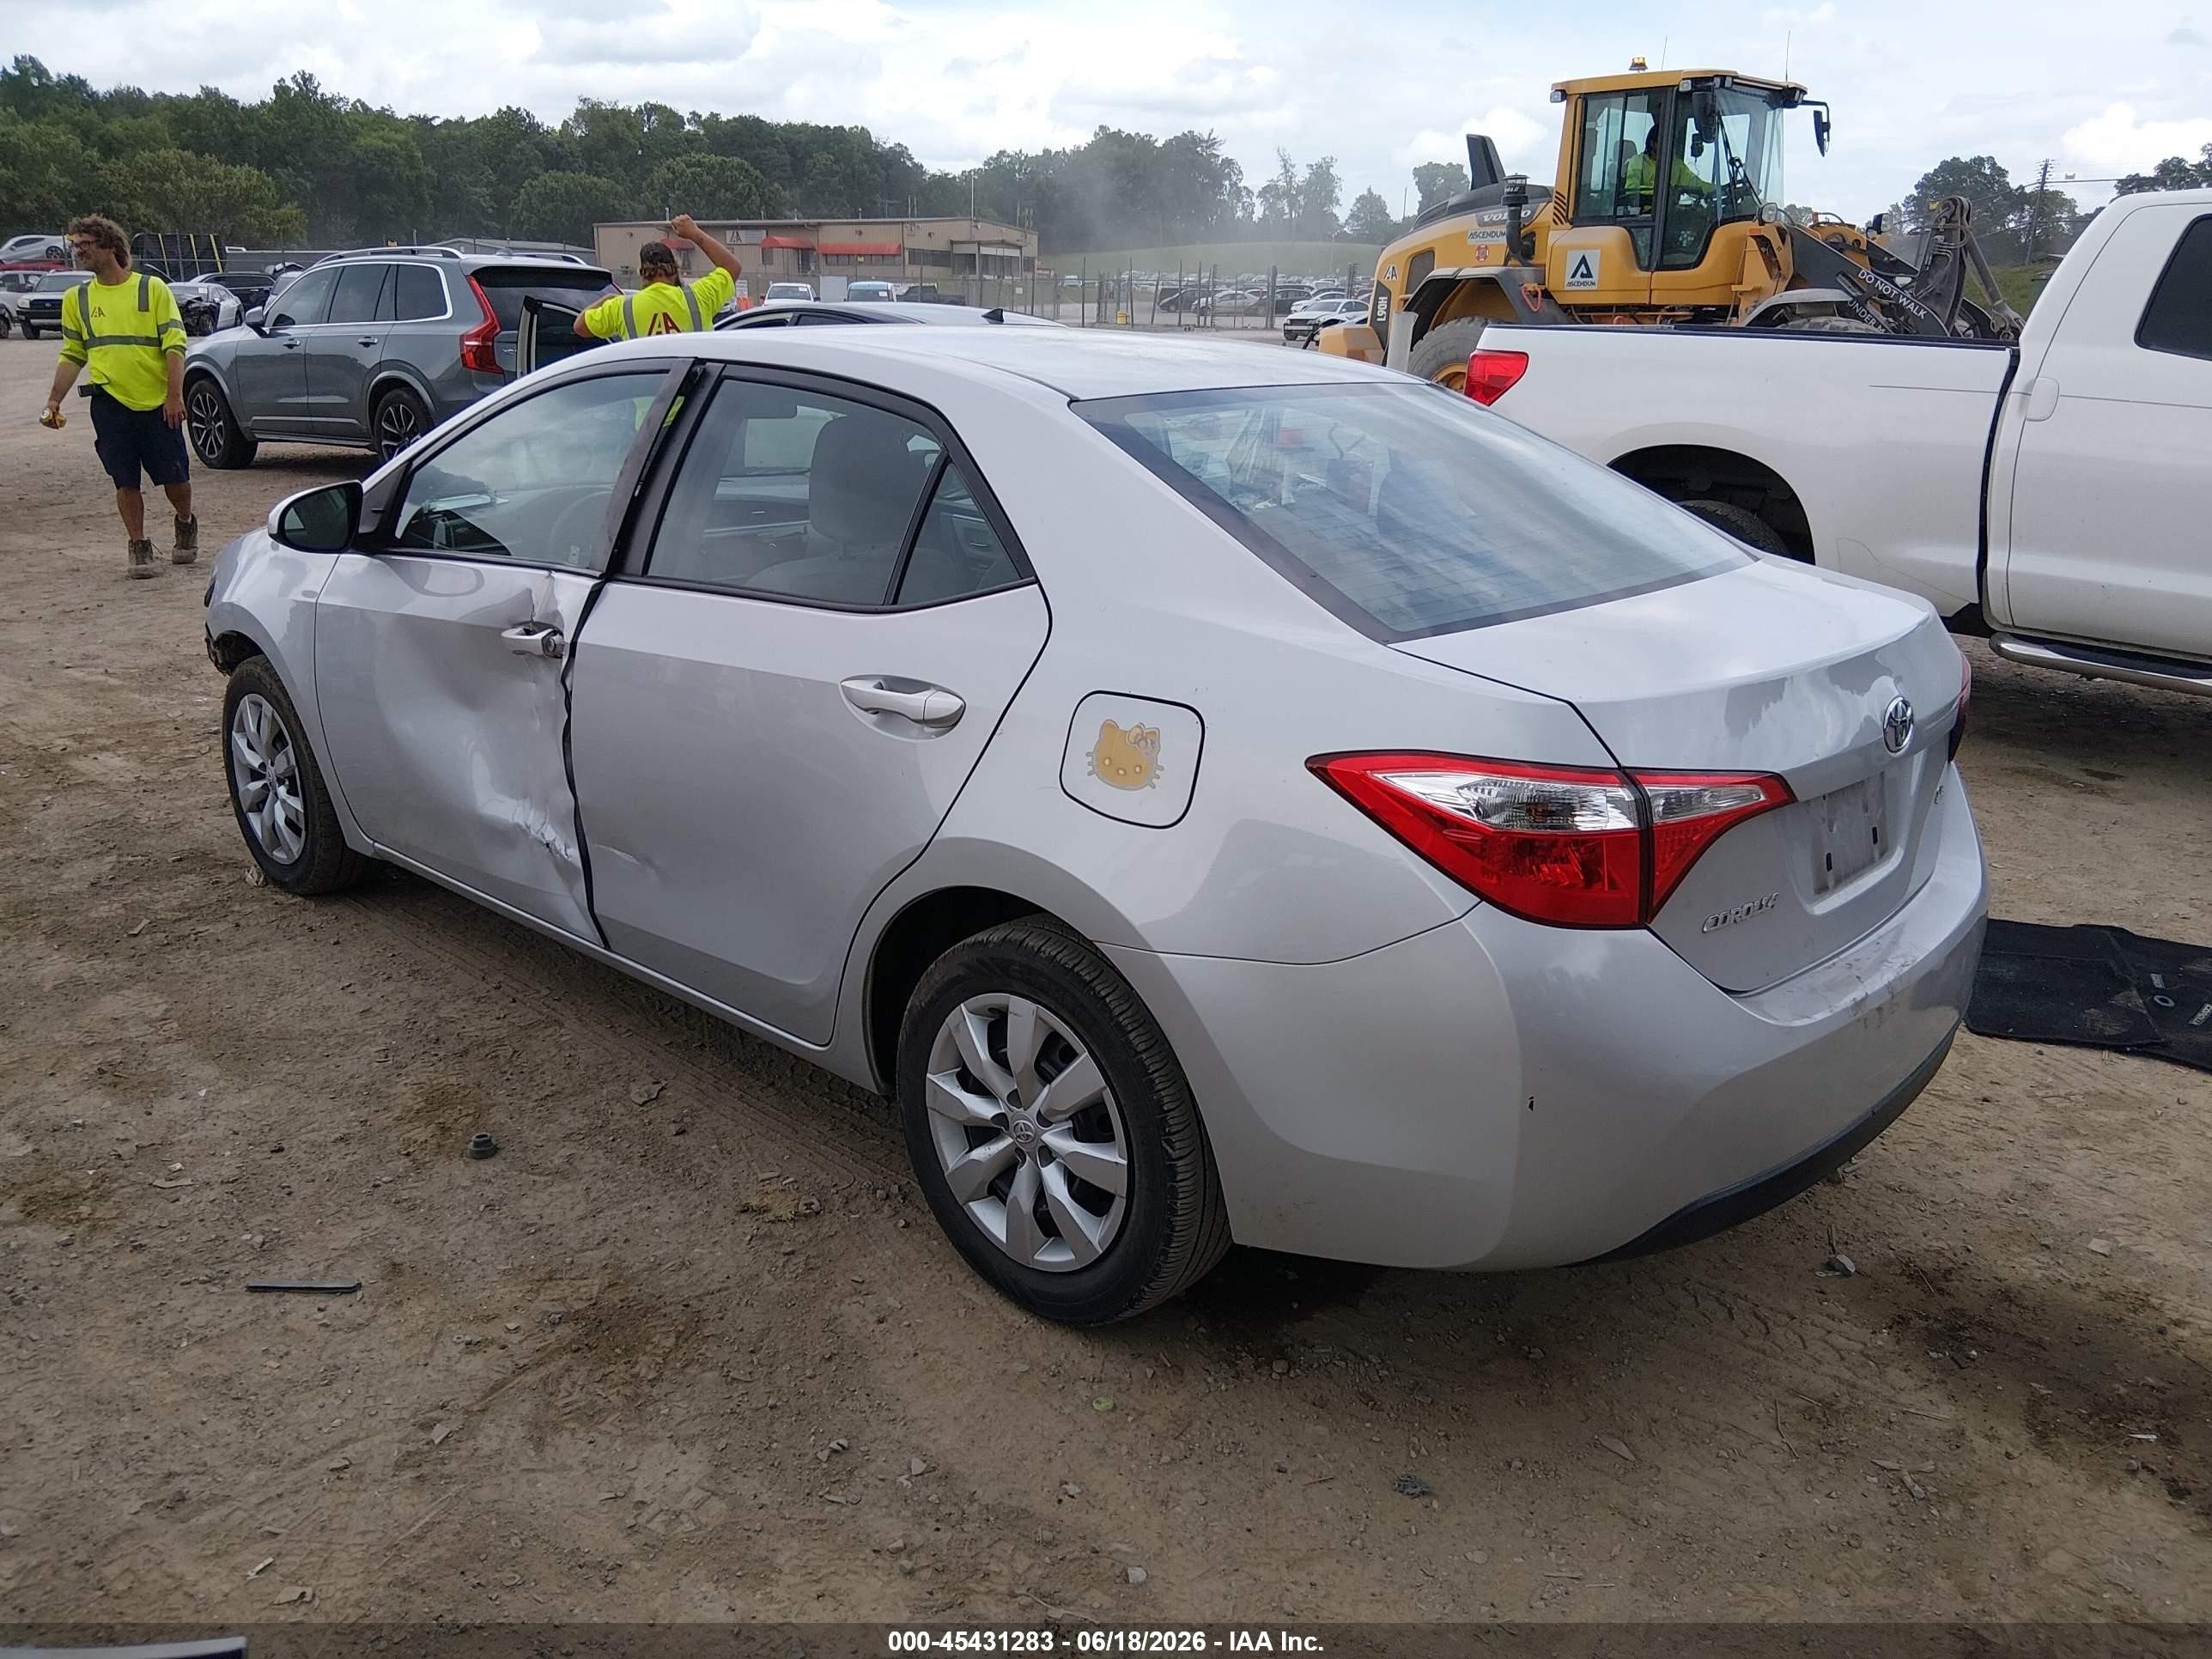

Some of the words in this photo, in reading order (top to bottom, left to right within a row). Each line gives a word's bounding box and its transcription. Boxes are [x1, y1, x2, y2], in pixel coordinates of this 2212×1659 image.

[1858, 269, 1875, 284] DO
[1874, 280, 1899, 299] NOT
[1898, 294, 1929, 320] WALK
[1376, 295, 1389, 322] L90H
[1847, 299, 1877, 326] UNDER
